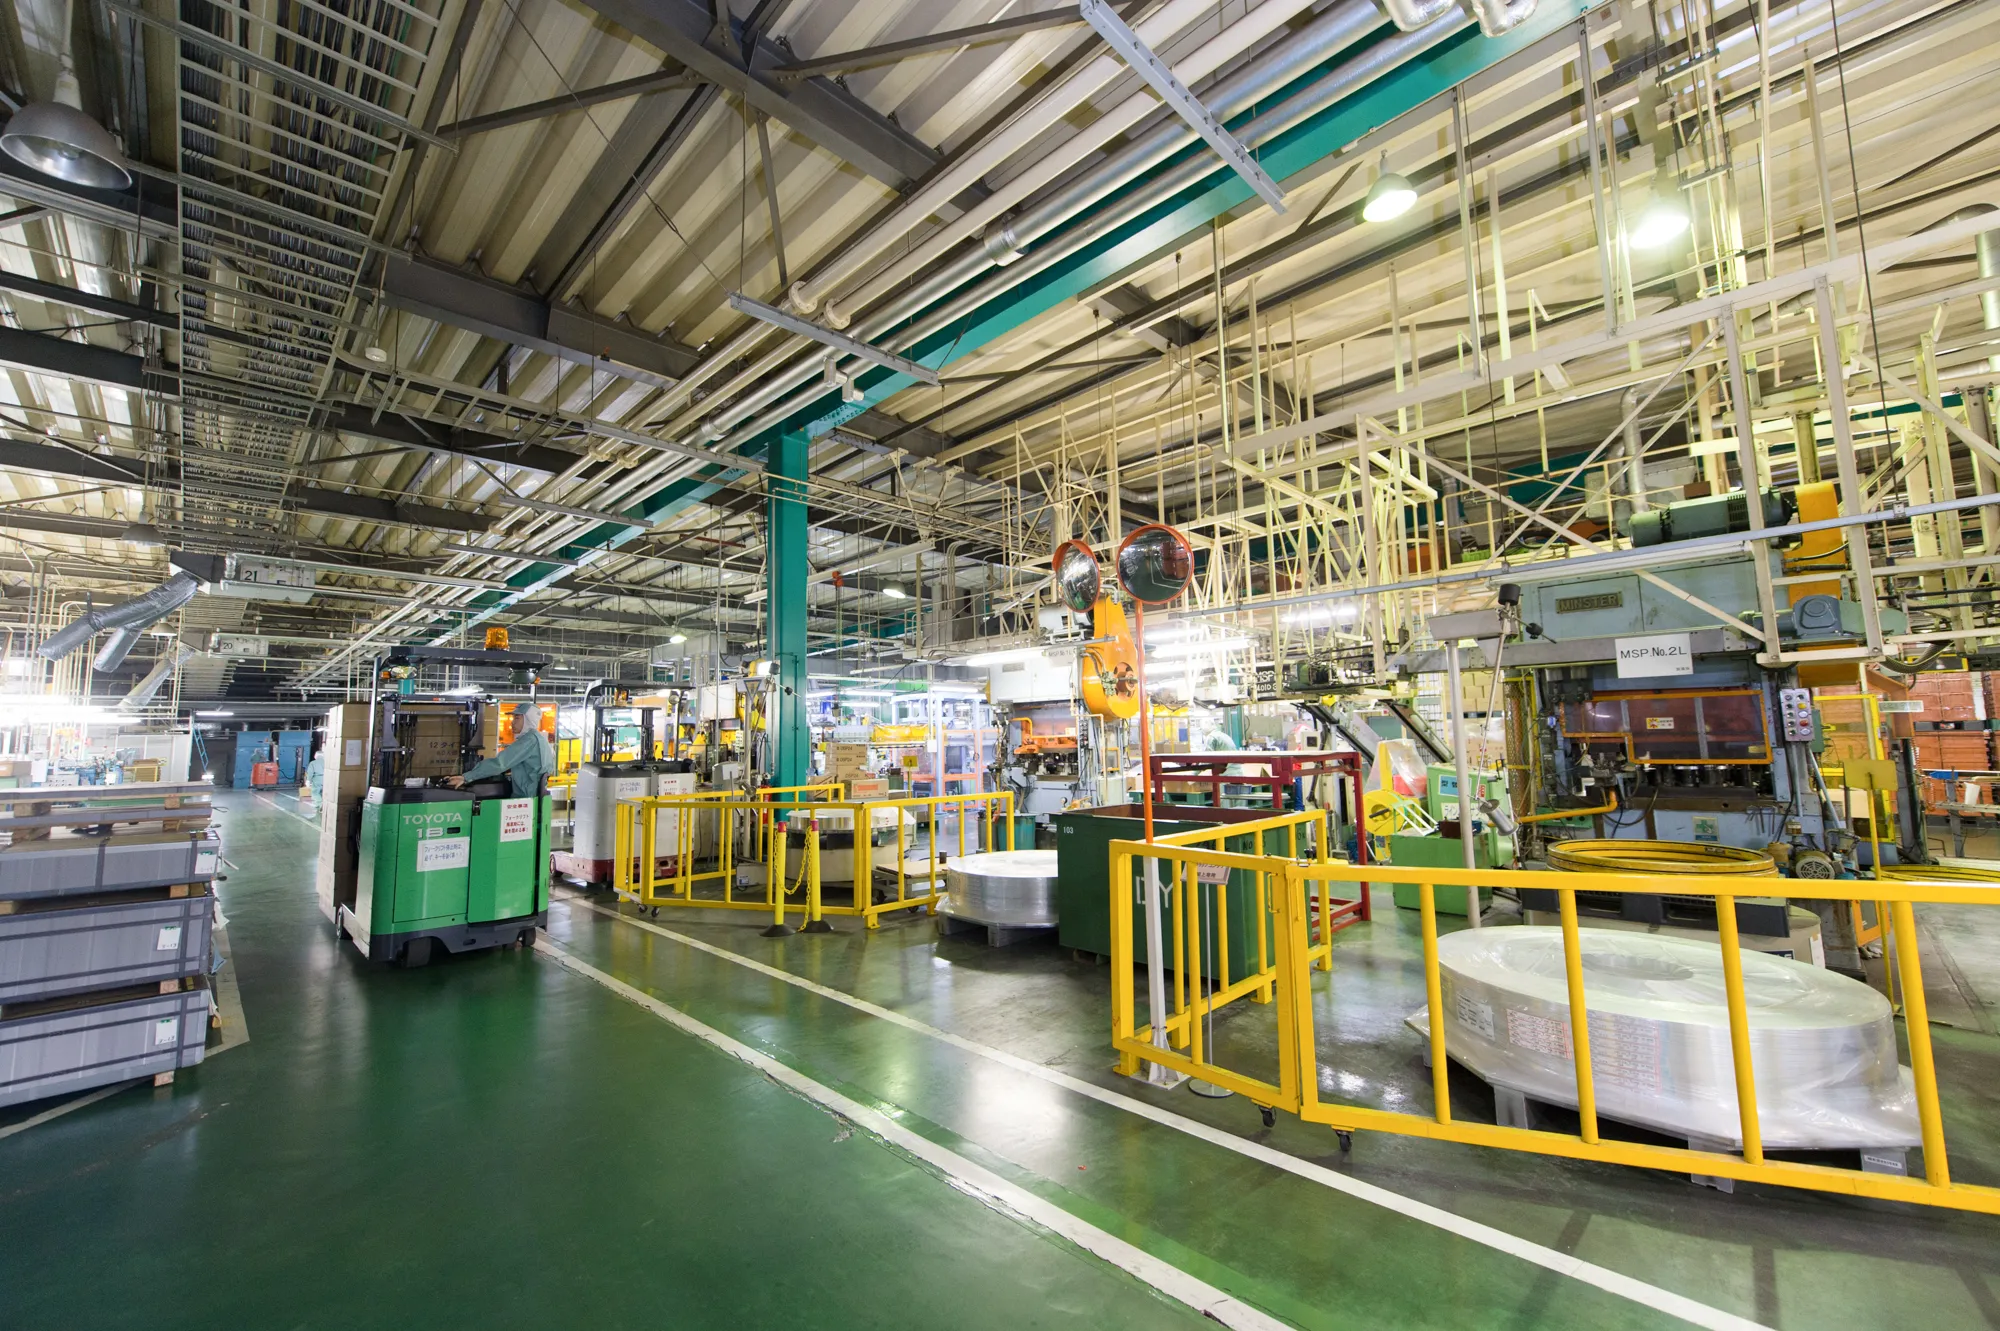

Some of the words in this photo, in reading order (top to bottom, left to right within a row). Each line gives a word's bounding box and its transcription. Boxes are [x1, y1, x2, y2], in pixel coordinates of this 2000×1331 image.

[244, 570, 258, 582] 21
[1560, 595, 1617, 611] MINSTER
[223, 642, 233, 650] 20
[403, 812, 462, 825] TOYOTA
[1063, 826, 1074, 834] 103
